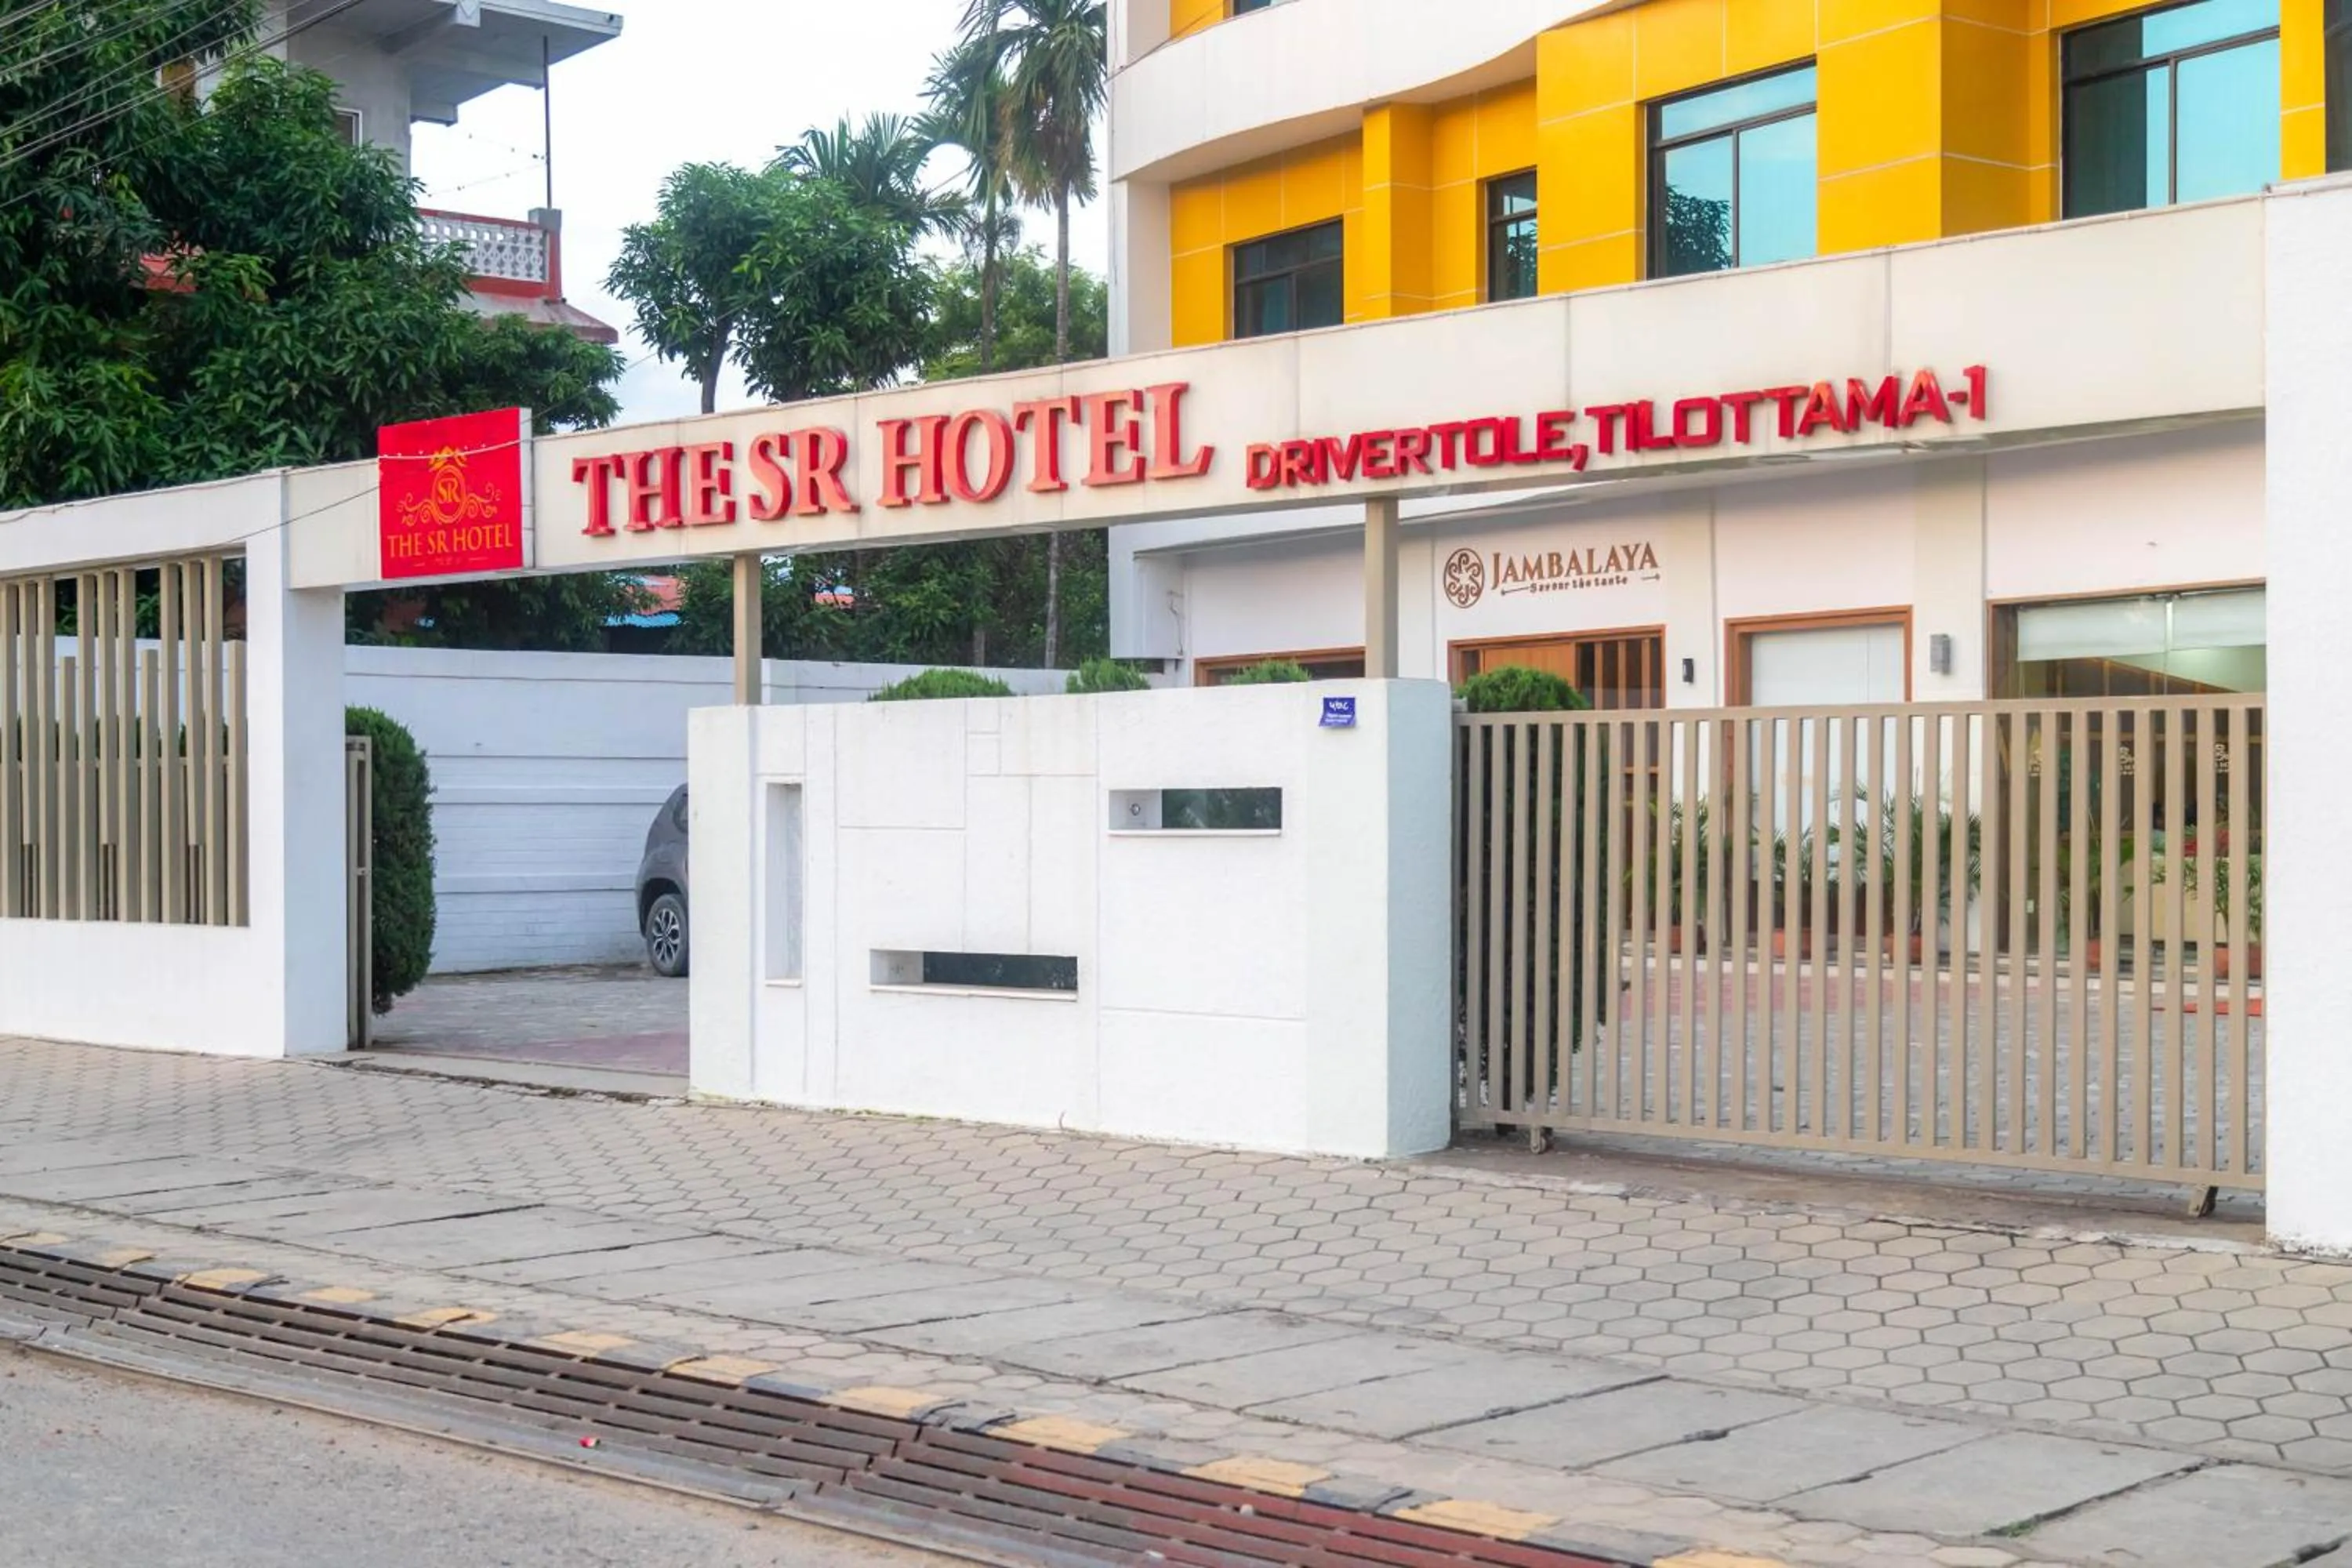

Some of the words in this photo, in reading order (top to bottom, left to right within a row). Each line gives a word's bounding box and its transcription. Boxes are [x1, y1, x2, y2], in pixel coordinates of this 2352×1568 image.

[573, 441, 735, 536] THE
[749, 426, 860, 521] SR
[877, 382, 1214, 507] HOTEL
[437, 477, 460, 503] SR
[387, 533, 423, 558] THE
[427, 531, 449, 554] SR
[453, 523, 514, 553] HOTEL
[1491, 542, 1658, 590] JAMBALAYA
